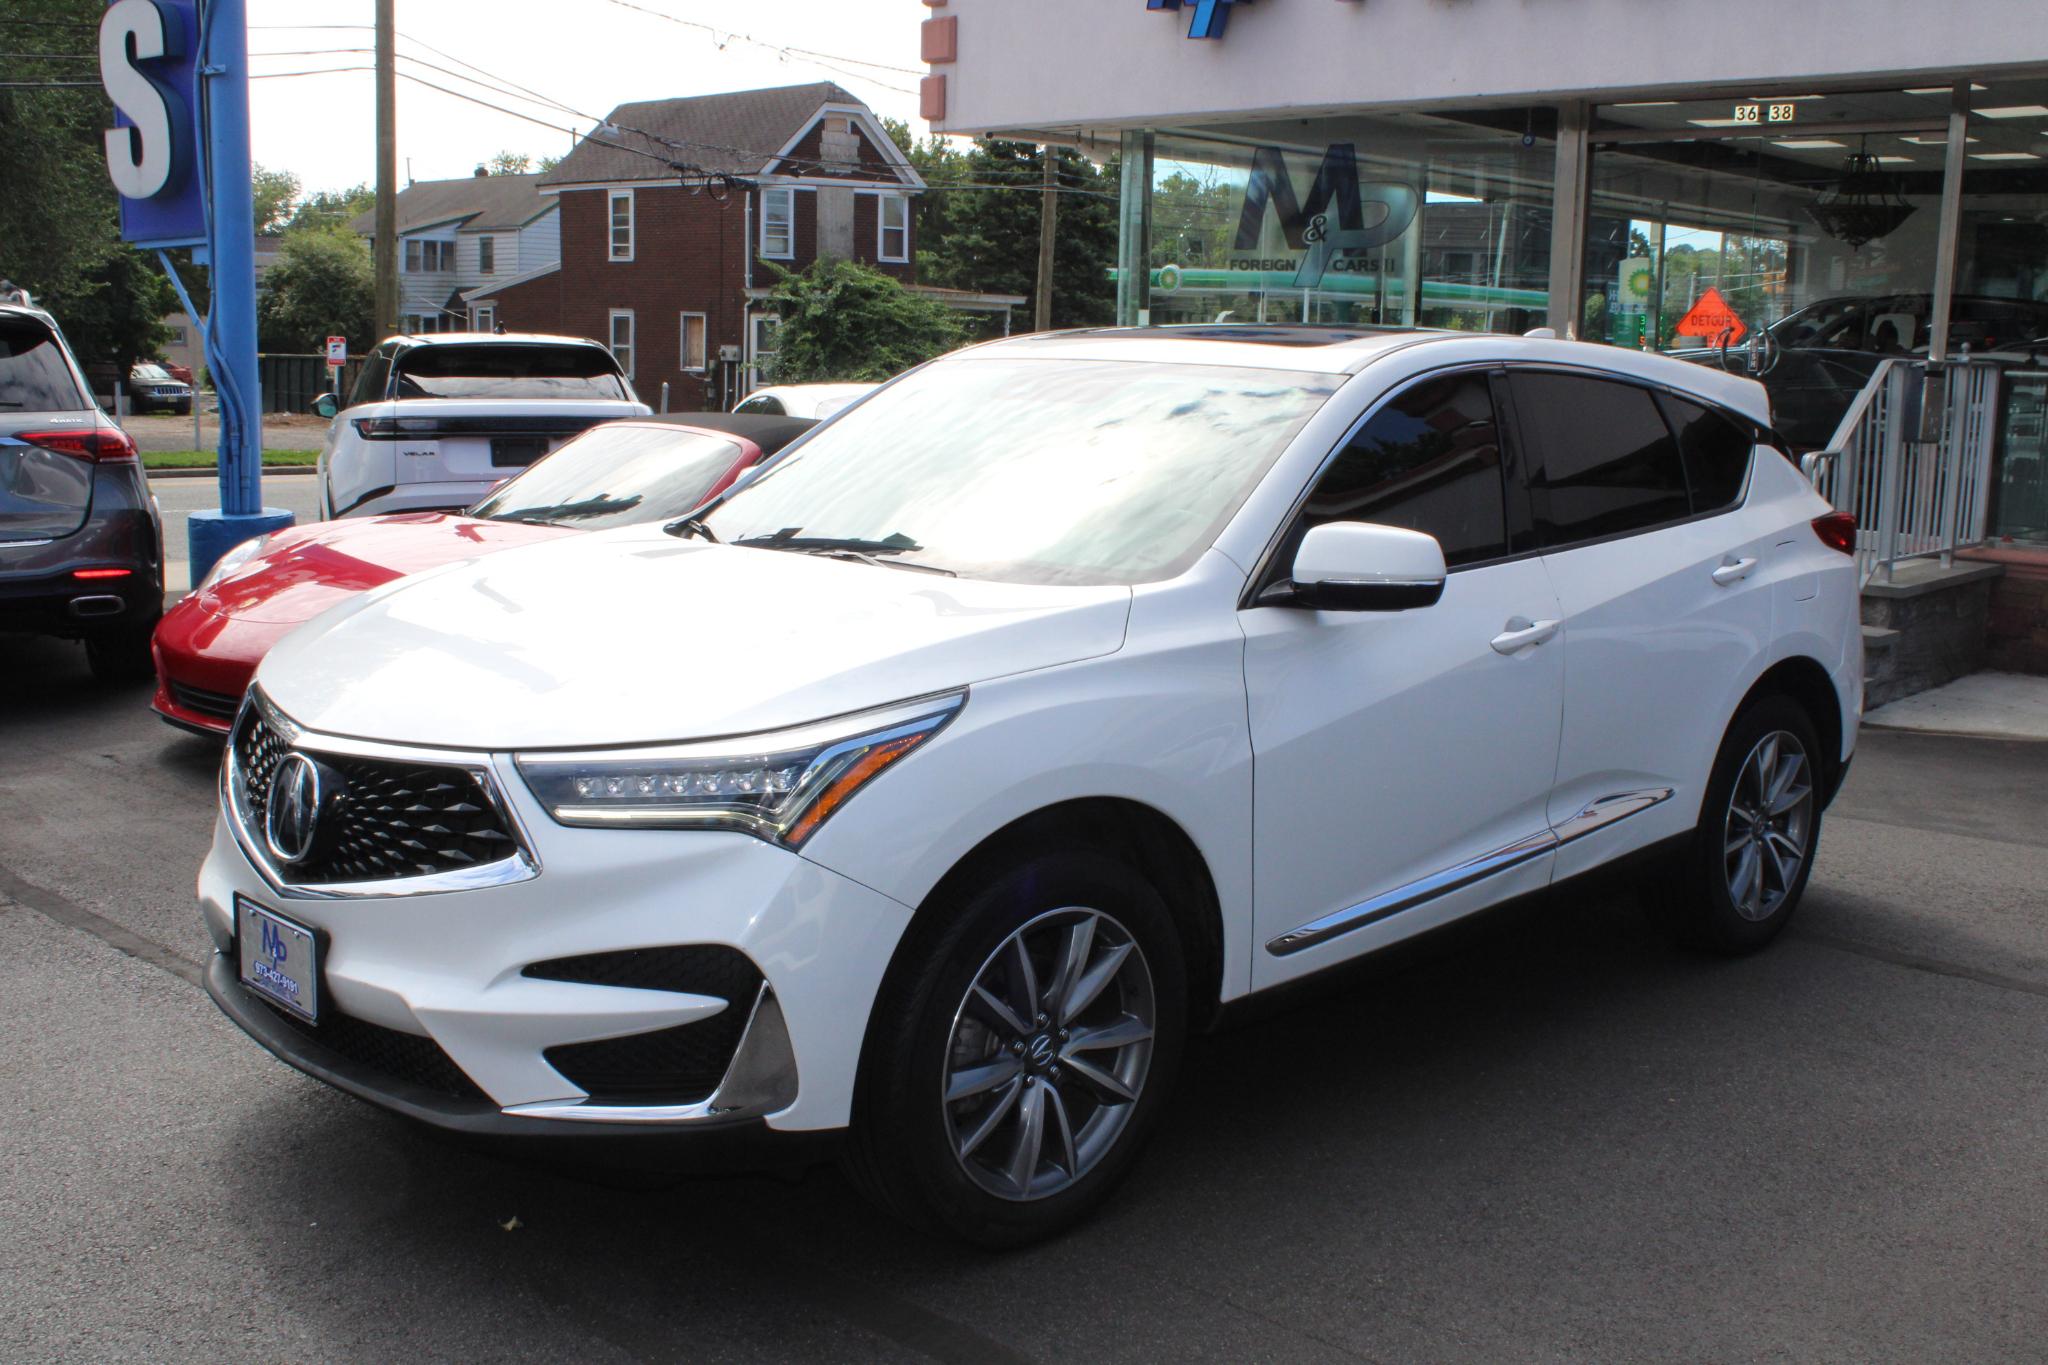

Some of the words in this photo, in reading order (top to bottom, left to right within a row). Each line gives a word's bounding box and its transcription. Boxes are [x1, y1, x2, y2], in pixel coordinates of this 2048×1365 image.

[98, 0, 171, 200] S
[1230, 258, 1297, 271] FOREIGN
[1333, 258, 1380, 272] CARS
[1691, 315, 1732, 327] DETOUR
